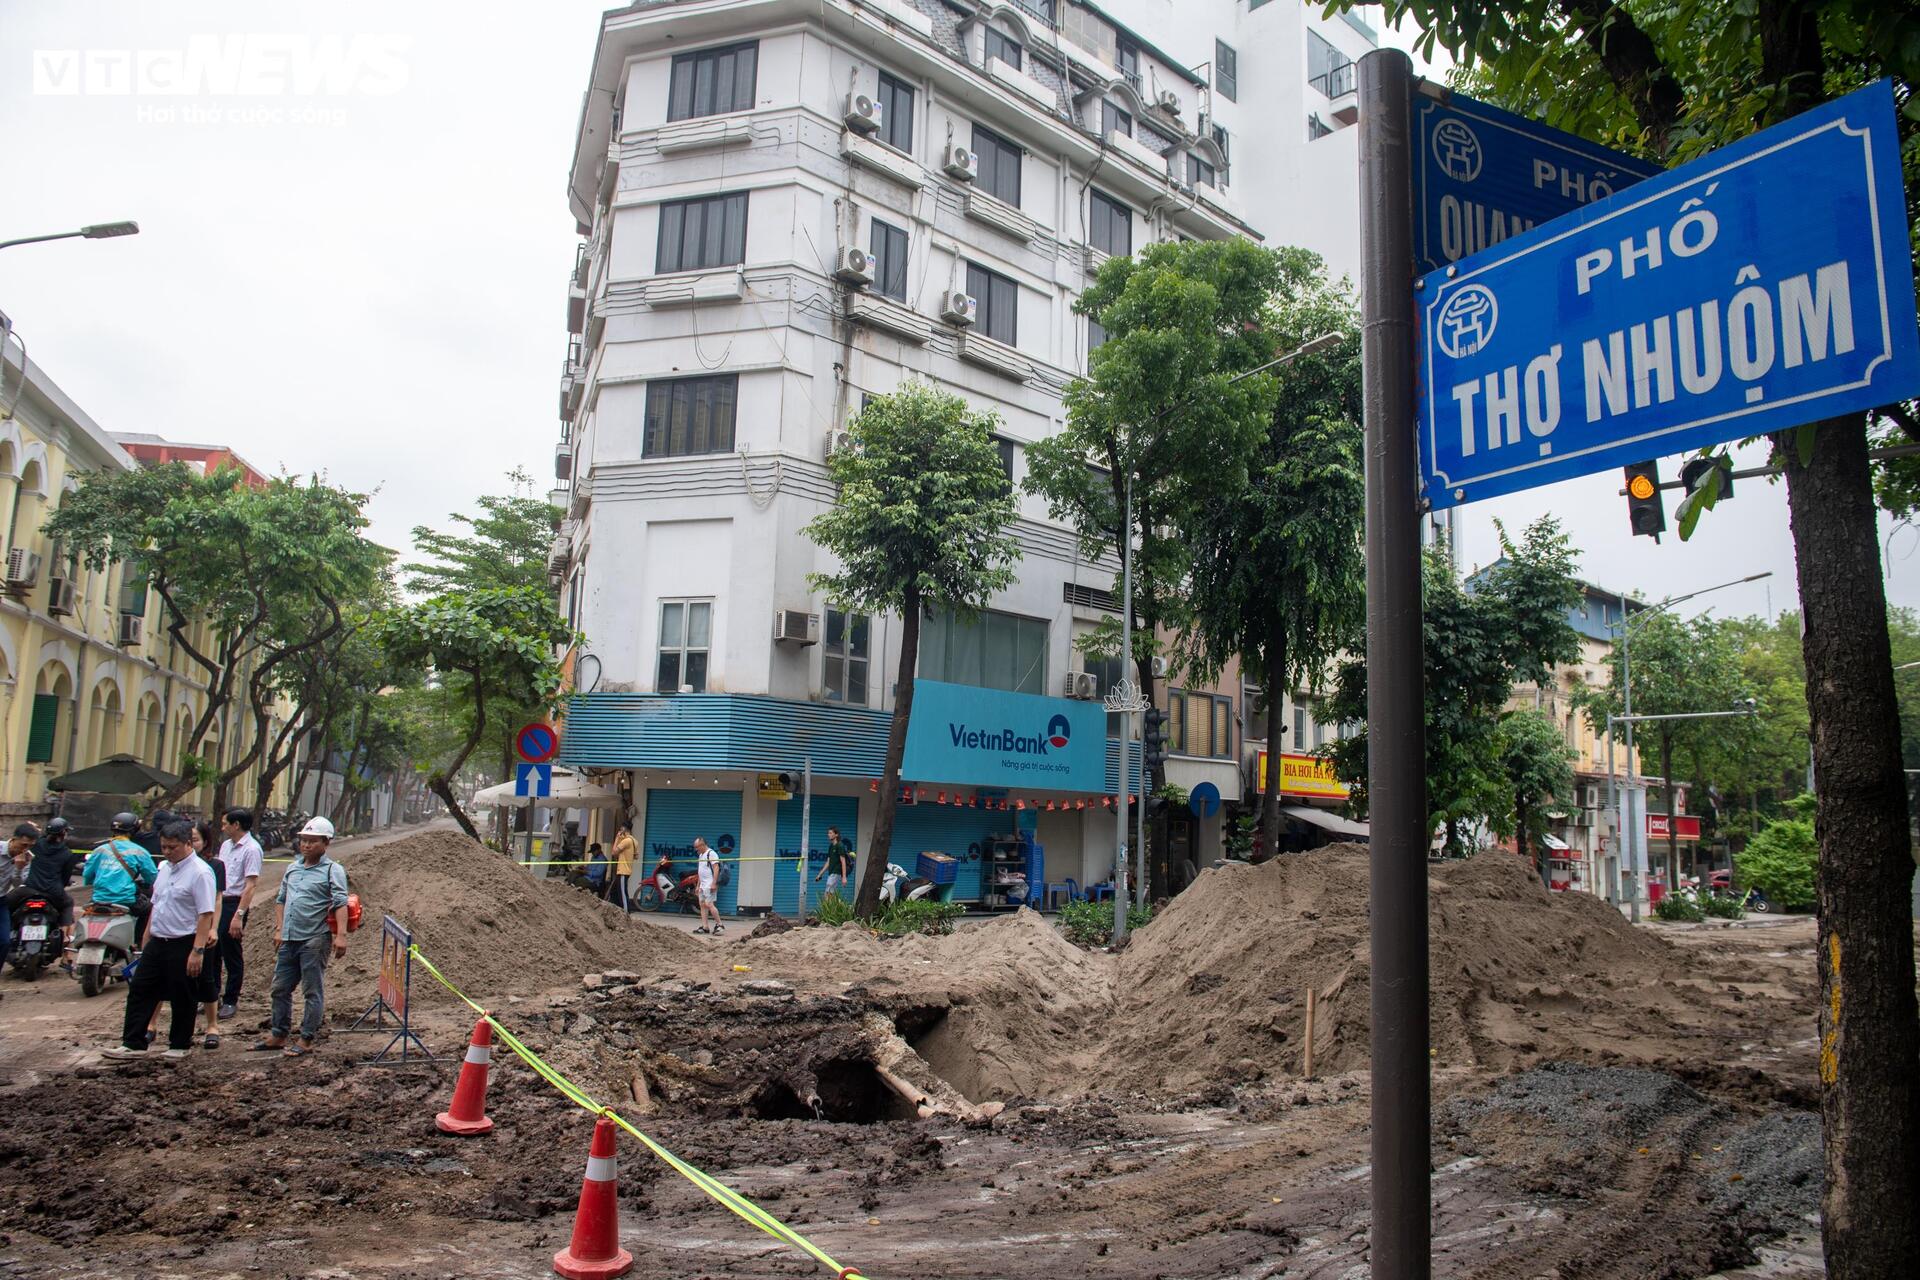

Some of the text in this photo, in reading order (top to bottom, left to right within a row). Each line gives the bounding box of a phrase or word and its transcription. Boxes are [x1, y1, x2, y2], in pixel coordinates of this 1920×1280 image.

[1533, 158, 1617, 204] PHỐ
[1576, 182, 1719, 295] PHỐ
[1452, 260, 1856, 456] THỢ NHUỘM
[949, 723, 1049, 755] VietinBank
[1001, 759, 1019, 771] Nâng
[1284, 763, 1297, 777] BIA
